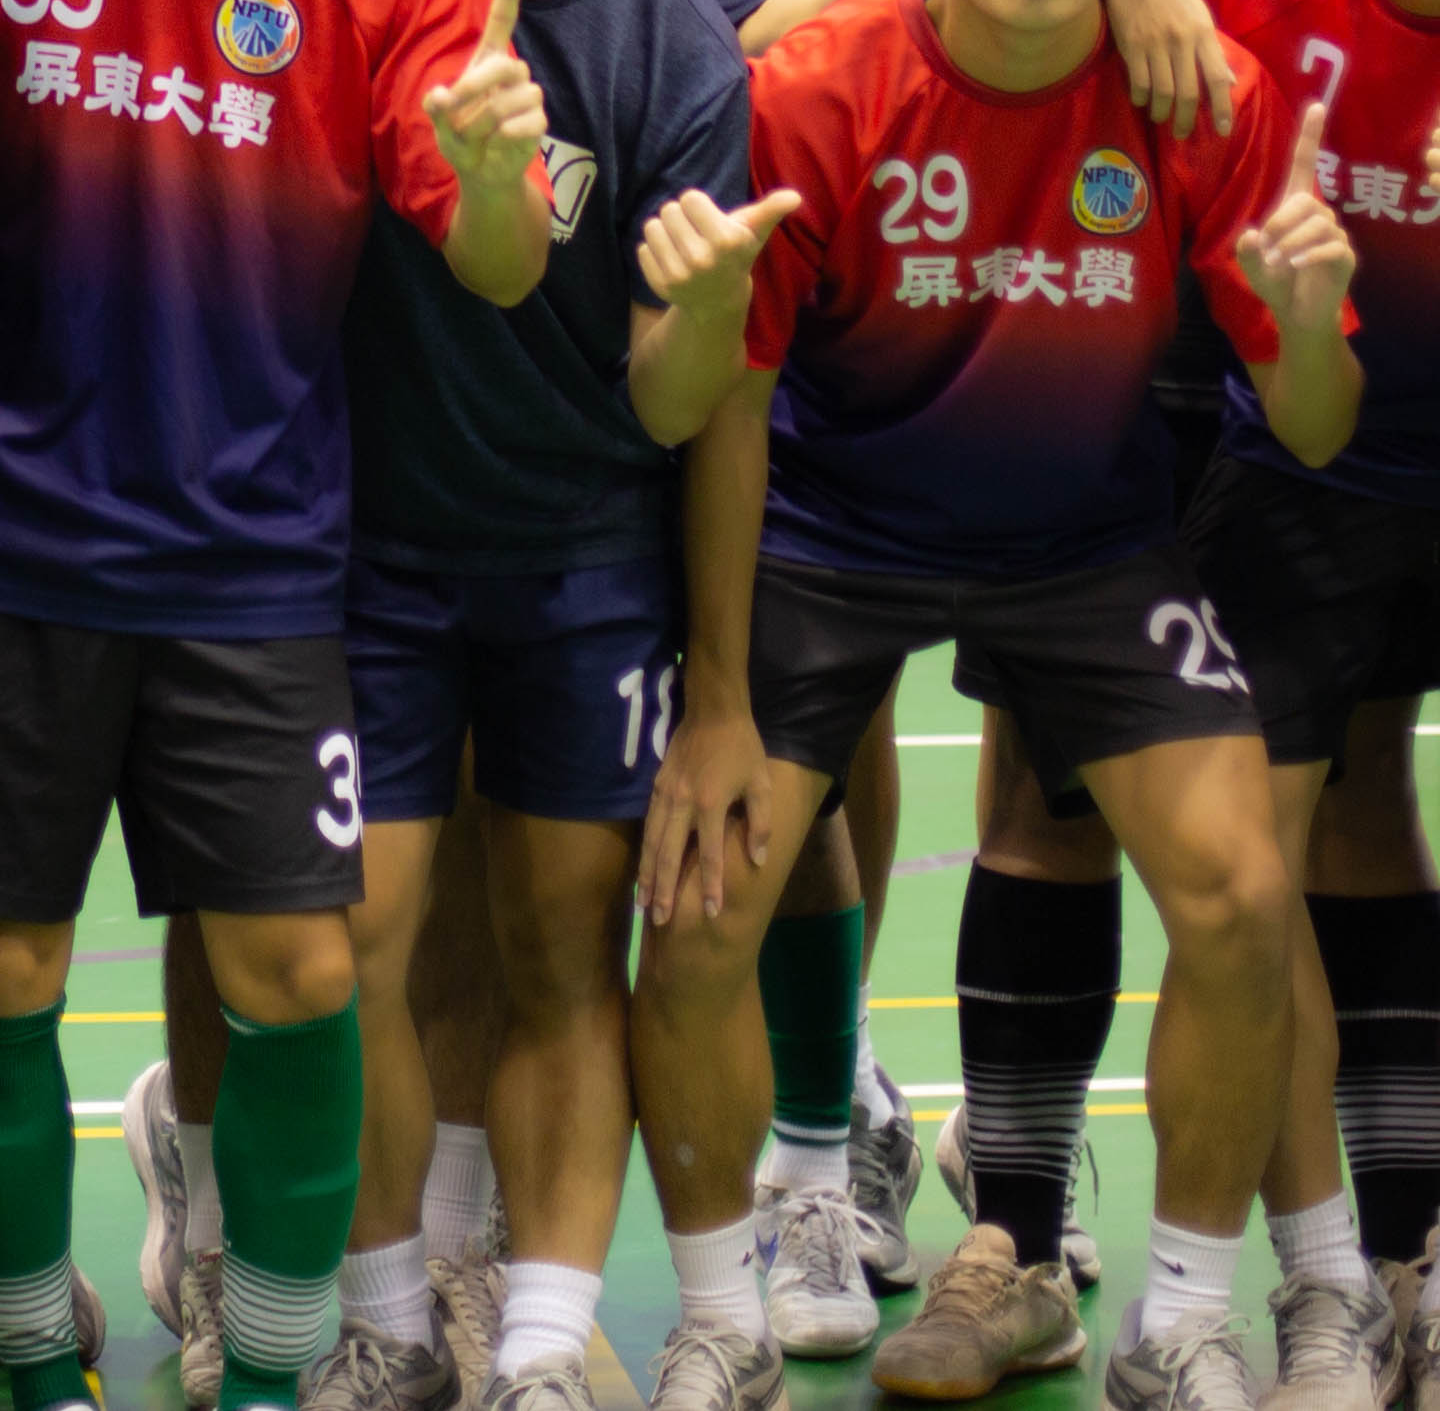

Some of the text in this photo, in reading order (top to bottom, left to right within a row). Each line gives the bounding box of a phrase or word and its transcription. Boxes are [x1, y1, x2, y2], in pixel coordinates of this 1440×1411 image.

[15, 40, 277, 149] 屏東大學
[872, 154, 969, 245] 29
[1081, 166, 1137, 190] NPTU
[894, 247, 1134, 309] 屏東大學
